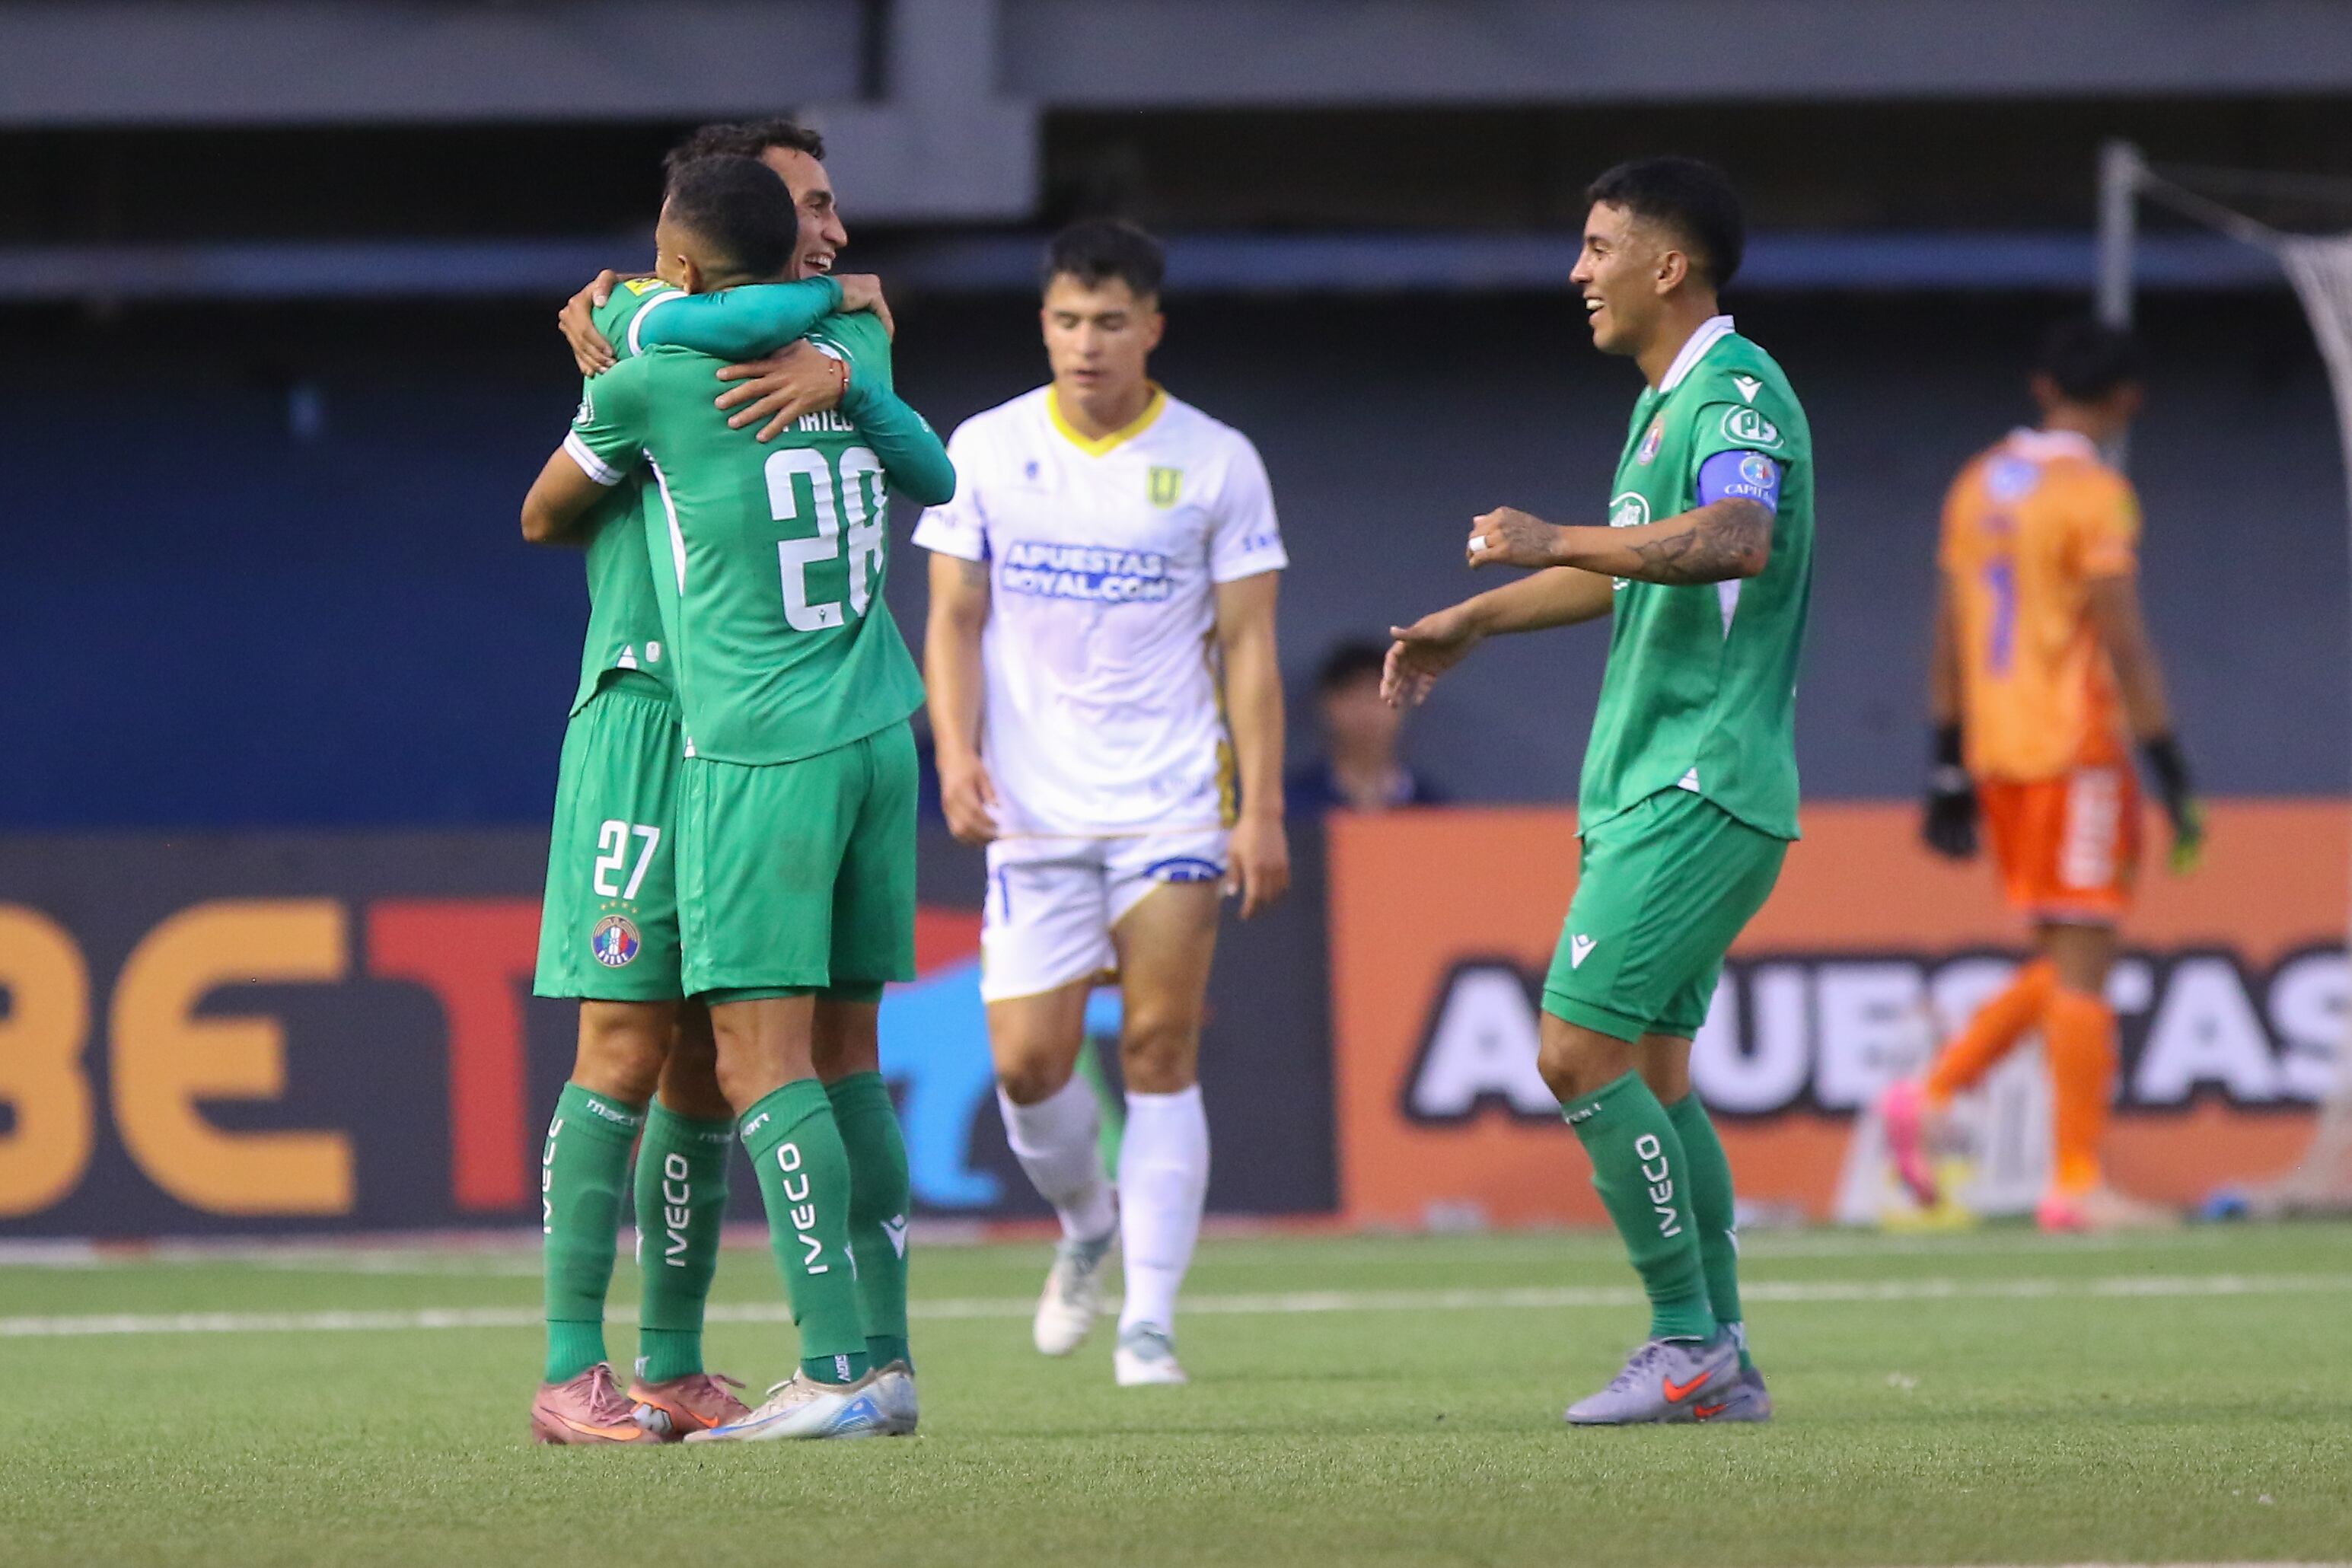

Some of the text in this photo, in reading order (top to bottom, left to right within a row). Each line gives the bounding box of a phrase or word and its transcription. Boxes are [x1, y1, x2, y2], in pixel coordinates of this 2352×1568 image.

[764, 446, 888, 633] 28
[1005, 542, 1165, 578] APUESTAS
[594, 819, 661, 900] 27
[1410, 945, 2347, 1117] AUEAS
[662, 1152, 690, 1267] IVECO
[776, 1142, 829, 1275] IVECO
[1634, 1133, 1682, 1238] IVECO
